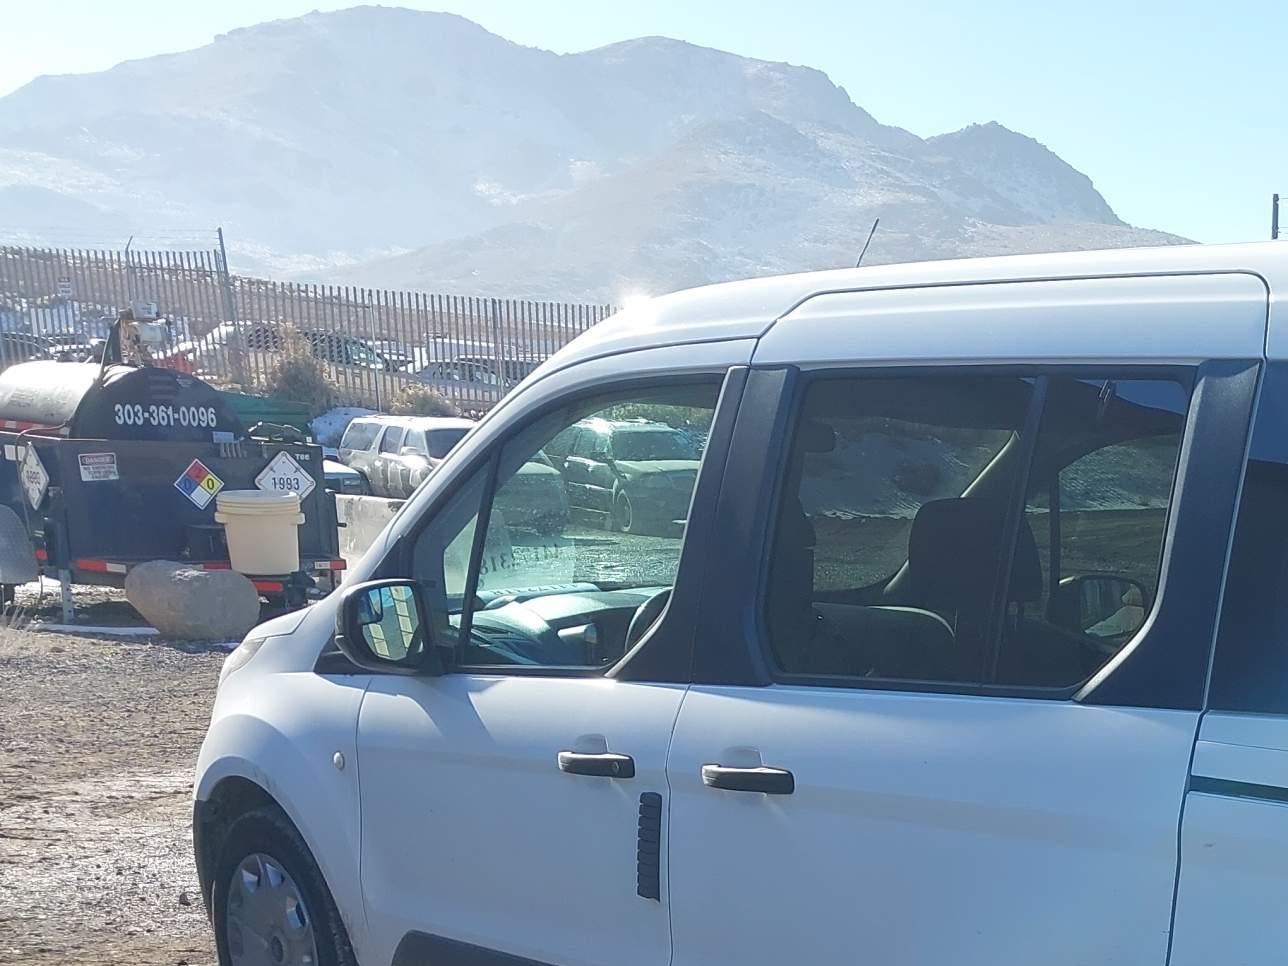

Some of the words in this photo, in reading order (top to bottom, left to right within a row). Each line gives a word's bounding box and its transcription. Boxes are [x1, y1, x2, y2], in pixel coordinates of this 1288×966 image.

[114, 403, 217, 428] 303-361-0096
[206, 477, 215, 490] 0
[271, 477, 301, 491] 1993
